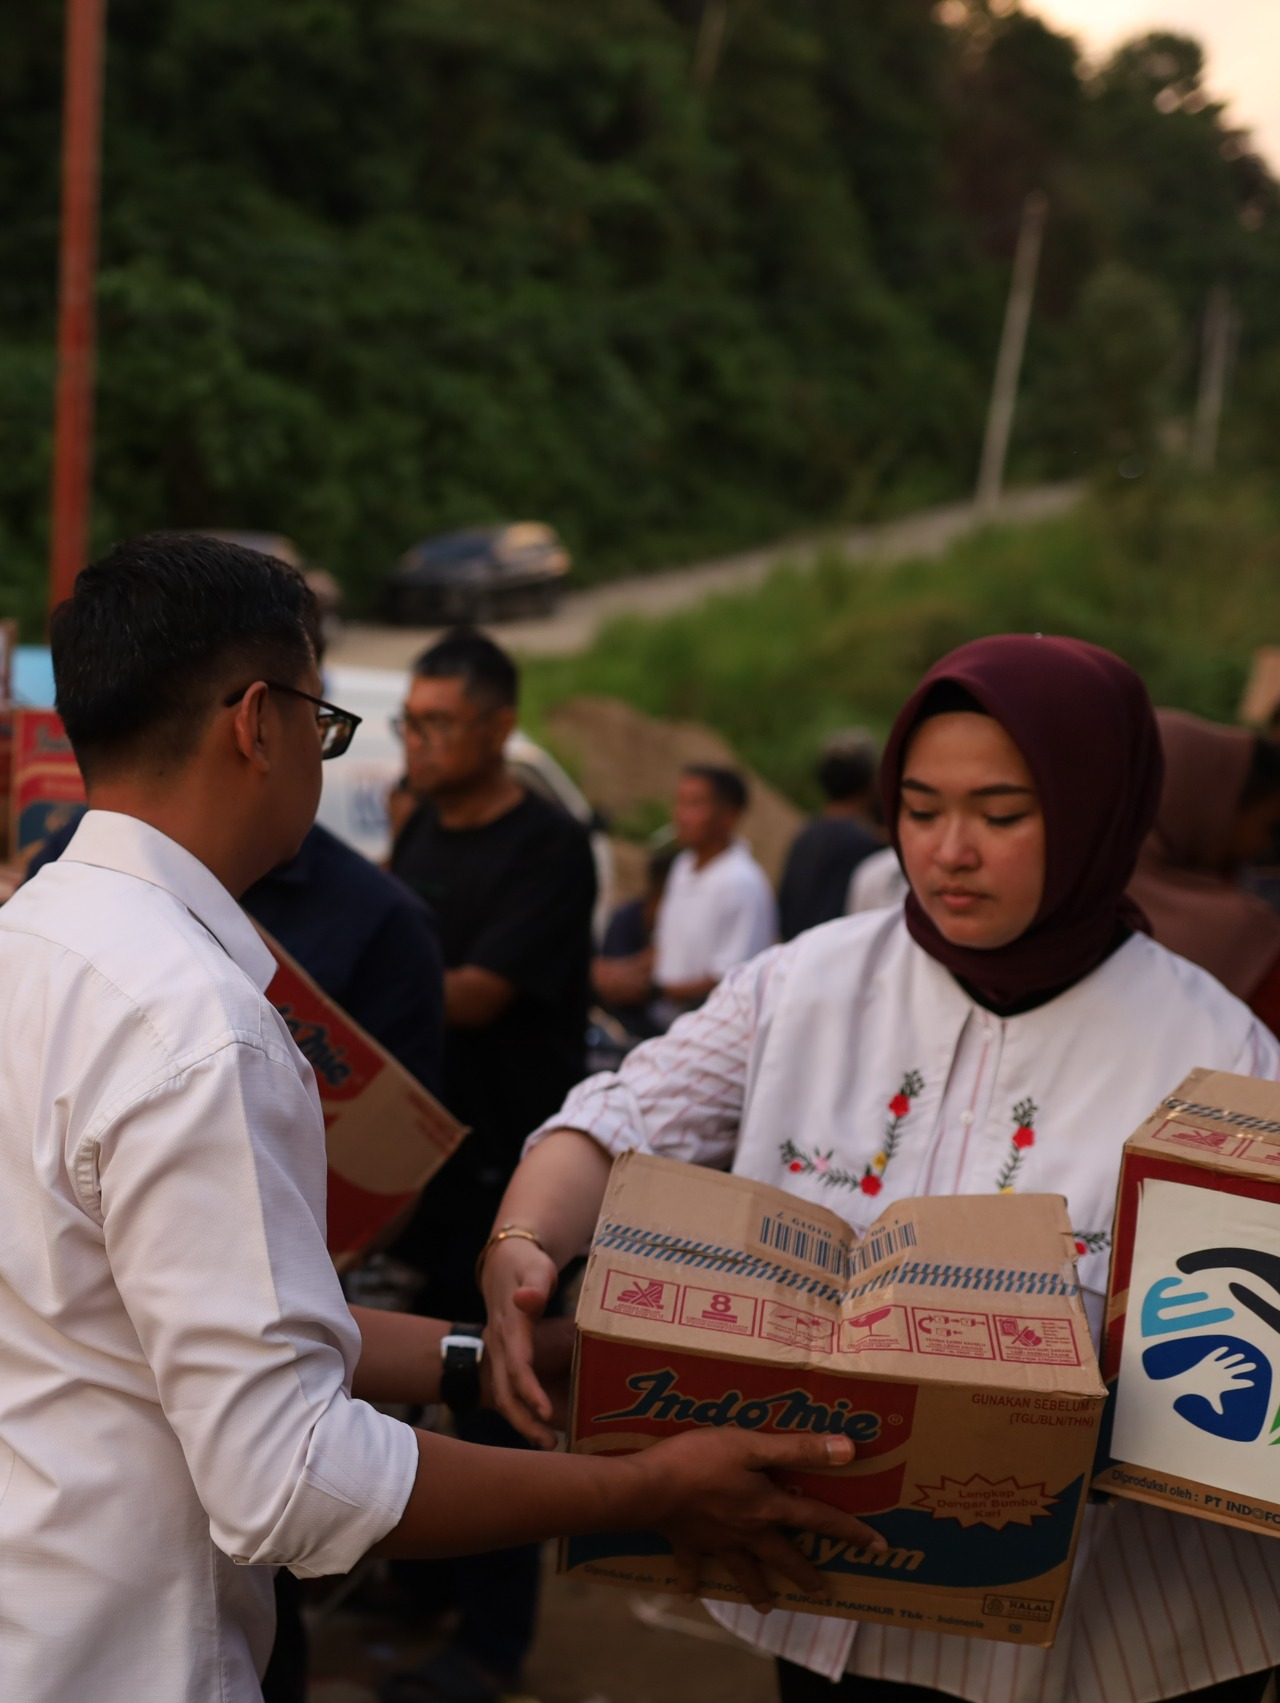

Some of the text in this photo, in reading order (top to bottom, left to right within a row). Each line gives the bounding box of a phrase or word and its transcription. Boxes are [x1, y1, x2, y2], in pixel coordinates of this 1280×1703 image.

[710, 1294, 731, 1313] 8
[971, 1393, 1031, 1410] GUNAKAN
[1034, 1399, 1090, 1412] SEBELUM
[1009, 1412, 1095, 1428] (TGL/BLN/THN)
[958, 1489, 1015, 1499] Lengkap
[1111, 1469, 1169, 1494] Diproduksi
[1169, 1485, 1193, 1500] oleh
[1204, 1494, 1222, 1508] PT
[937, 1499, 1038, 1511] Dengan Bumbu
[974, 1510, 1001, 1518] Kari
[836, 1600, 895, 1616] MAKMUR
[900, 1609, 924, 1621] Tbk
[1009, 1600, 1049, 1612] HALAL
